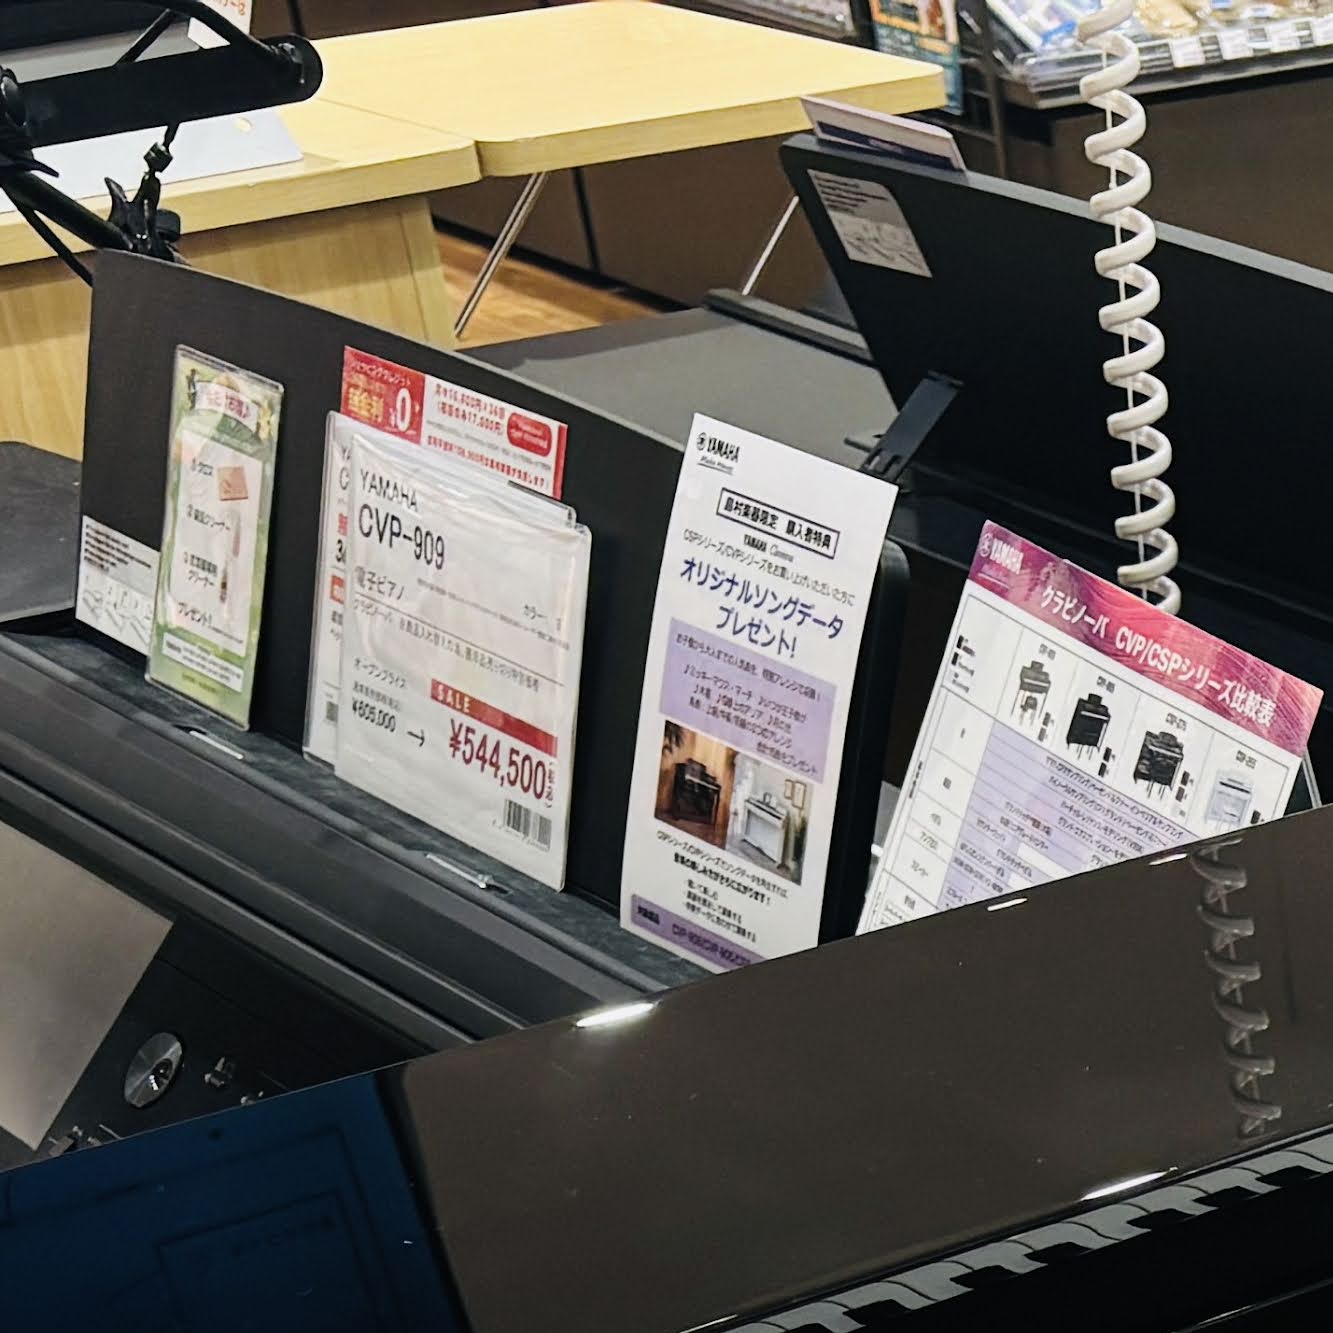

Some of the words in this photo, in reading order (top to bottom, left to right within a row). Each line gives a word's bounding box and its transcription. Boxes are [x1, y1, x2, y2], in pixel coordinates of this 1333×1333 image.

[707, 434, 740, 463] YAMAHA
[360, 468, 418, 512] YAMAHA
[358, 503, 446, 571] CVP-909
[991, 539, 1025, 576] YAMAHA
[680, 556, 844, 640] オリジナルソングデータ
[716, 605, 797, 659] プレゼント!
[1040, 584, 1110, 640] クラビノーバ
[1115, 625, 1279, 728] CVP/CSPシリーズ比較表
[436, 683, 471, 714] SALE
[449, 717, 546, 801] ¥544,500
